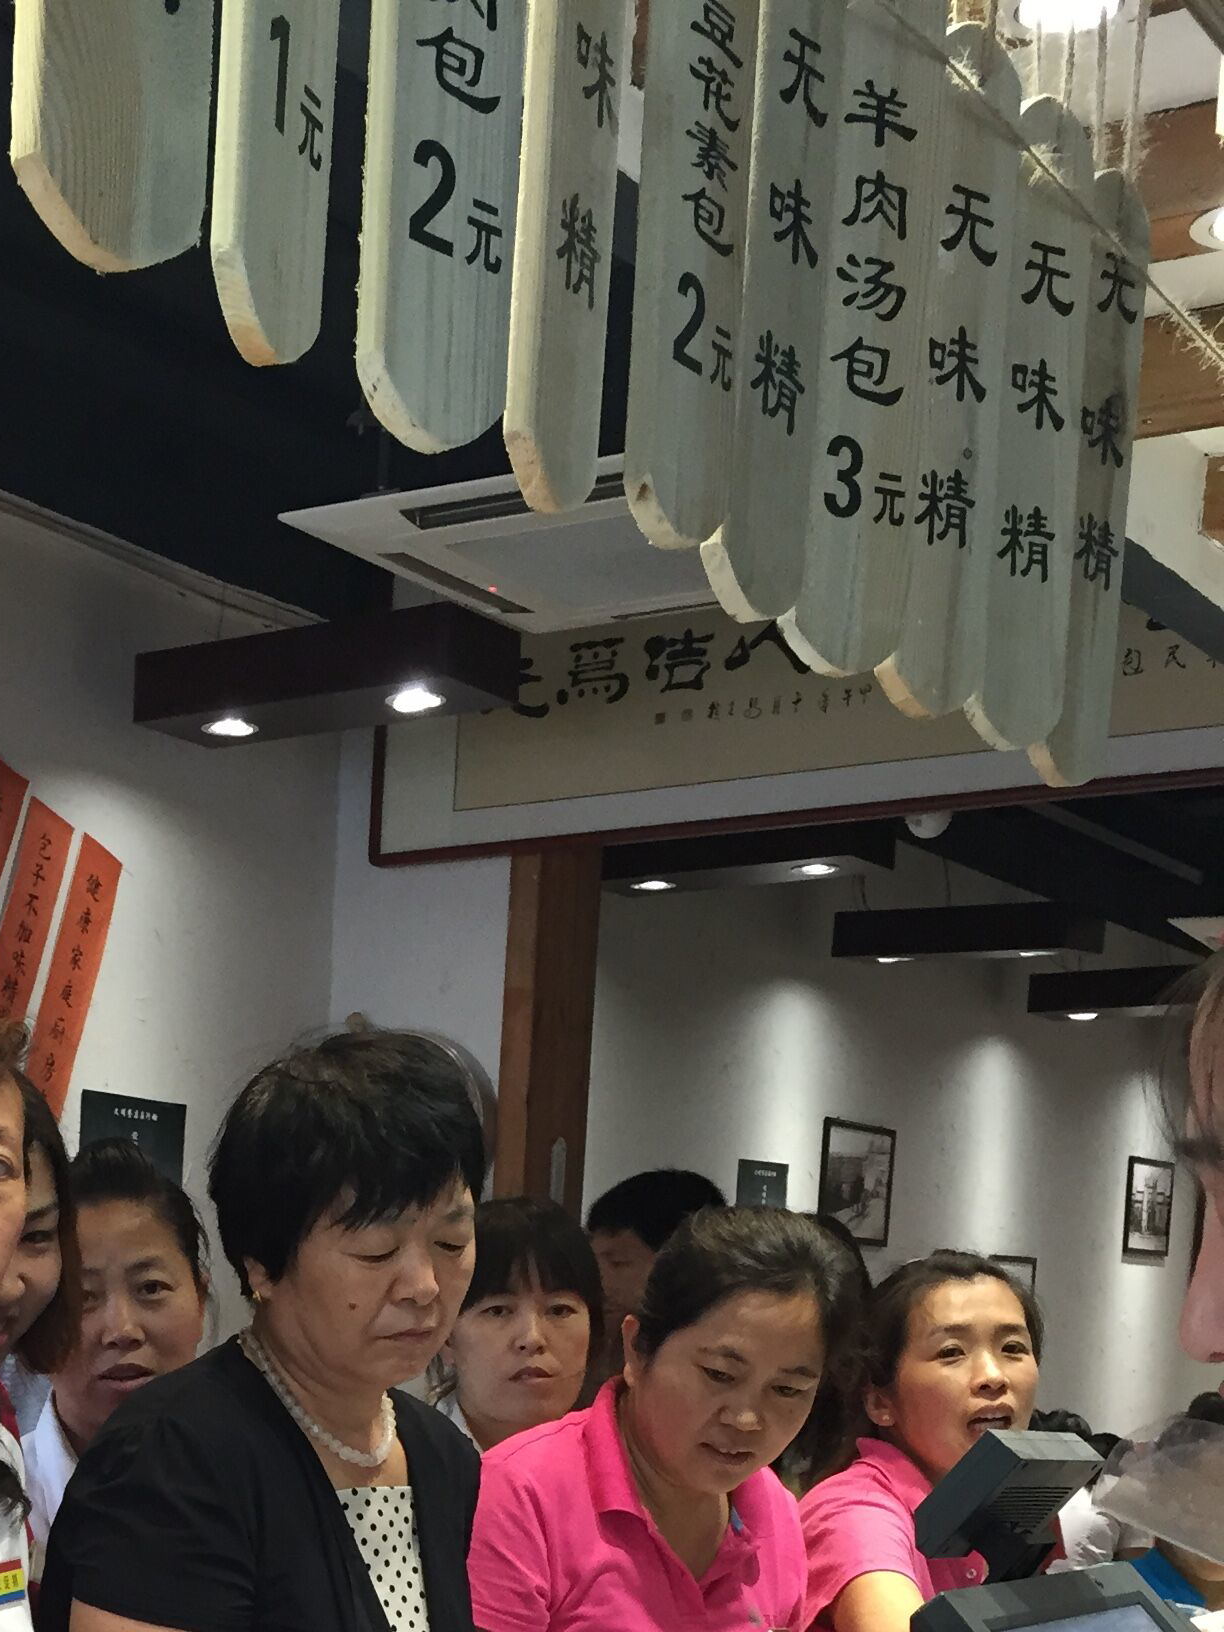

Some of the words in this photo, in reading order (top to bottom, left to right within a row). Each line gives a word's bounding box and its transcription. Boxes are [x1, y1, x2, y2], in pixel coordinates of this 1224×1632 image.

[269, 15, 324, 171] 1元
[408, 138, 504, 274] 2元
[682, 0, 744, 257] 豆花素包
[672, 271, 733, 394] 2元
[750, 26, 829, 436] 无味精
[830, 80, 918, 407] 羊肉汤包
[824, 436, 907, 528] 3元
[913, 183, 998, 549] 无味精
[997, 241, 1077, 583] 无味精
[1076, 250, 1138, 592] 无味精
[39, 872, 103, 1101] 健康家庭厨房
